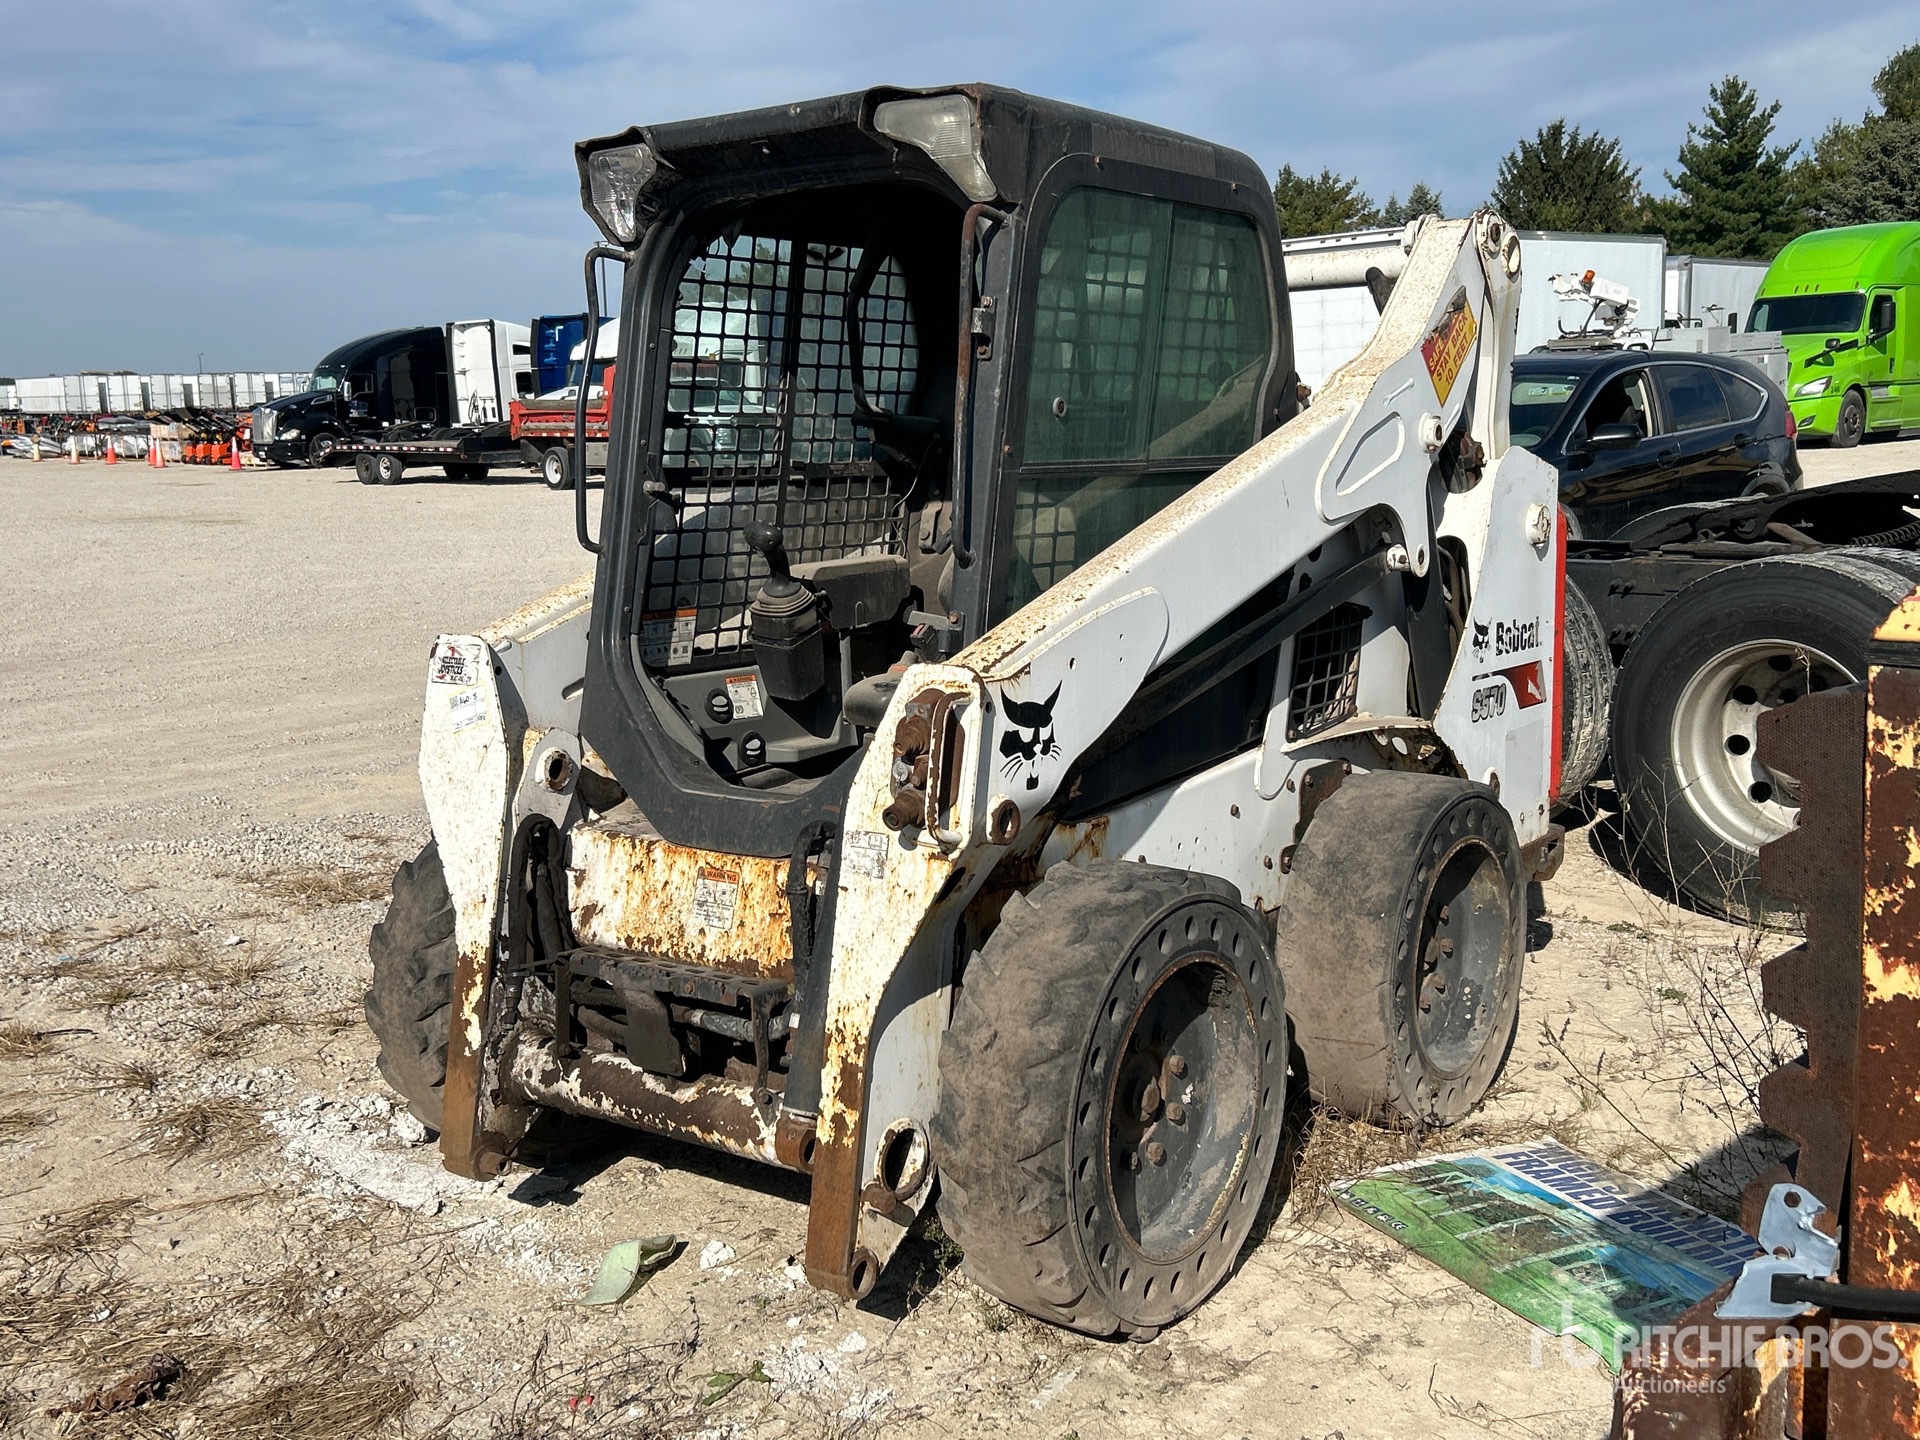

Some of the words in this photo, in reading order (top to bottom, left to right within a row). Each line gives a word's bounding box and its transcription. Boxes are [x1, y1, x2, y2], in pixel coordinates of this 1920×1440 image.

[1436, 348, 1452, 381] STAY
[1451, 315, 1468, 348] BACK
[1445, 370, 1454, 385] 10
[1453, 333, 1469, 368] FEET
[1496, 616, 1540, 656] Bobcat
[1471, 683, 1507, 723] S570
[707, 870, 737, 882] WARNNG
[1492, 1151, 1627, 1209] FRAMED
